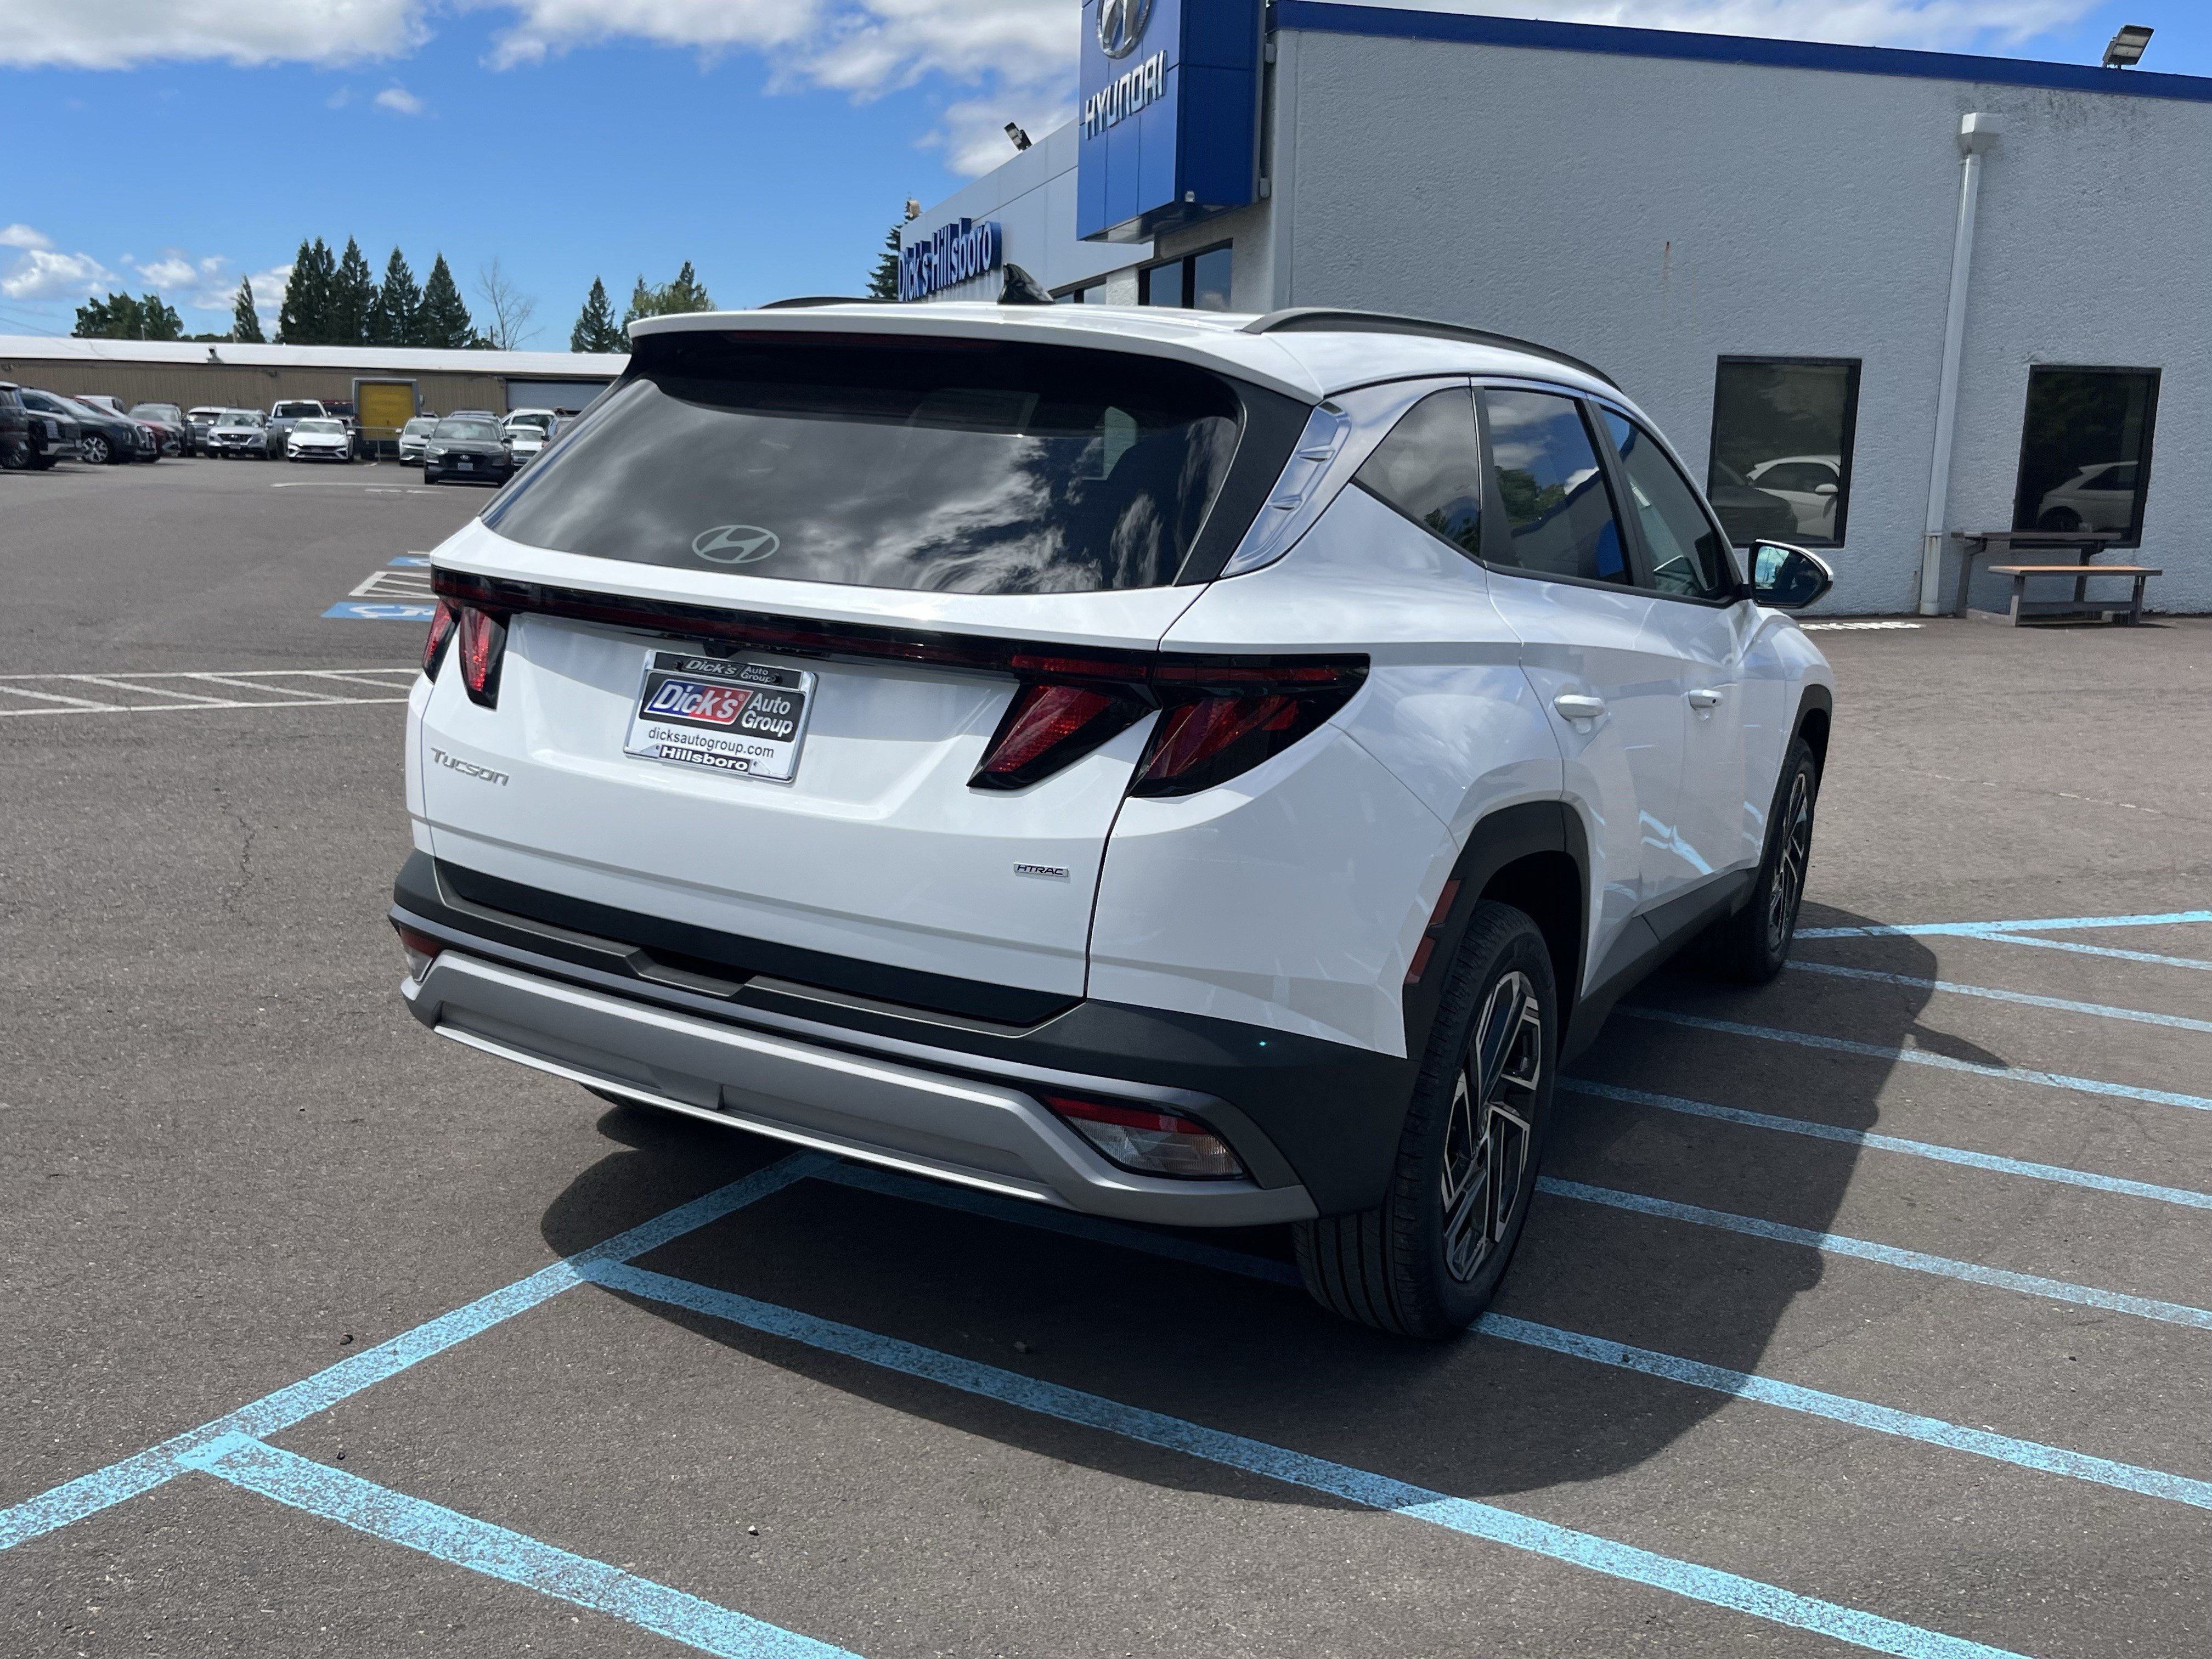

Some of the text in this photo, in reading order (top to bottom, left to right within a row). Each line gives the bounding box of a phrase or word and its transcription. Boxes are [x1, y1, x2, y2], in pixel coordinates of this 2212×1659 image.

[1085, 50, 1167, 140] HYUNDAI
[898, 218, 994, 302] Dick's Hillsboro
[686, 659, 737, 675] Dick's
[741, 672, 772, 684] Group
[743, 665, 769, 675] Auto
[653, 684, 738, 719] Dick's
[748, 692, 791, 715] Auto
[742, 710, 793, 737] Group
[648, 727, 774, 758] dicksautogroup.com
[660, 747, 748, 771] Hillsboro
[1017, 864, 1064, 876] HTRAC
